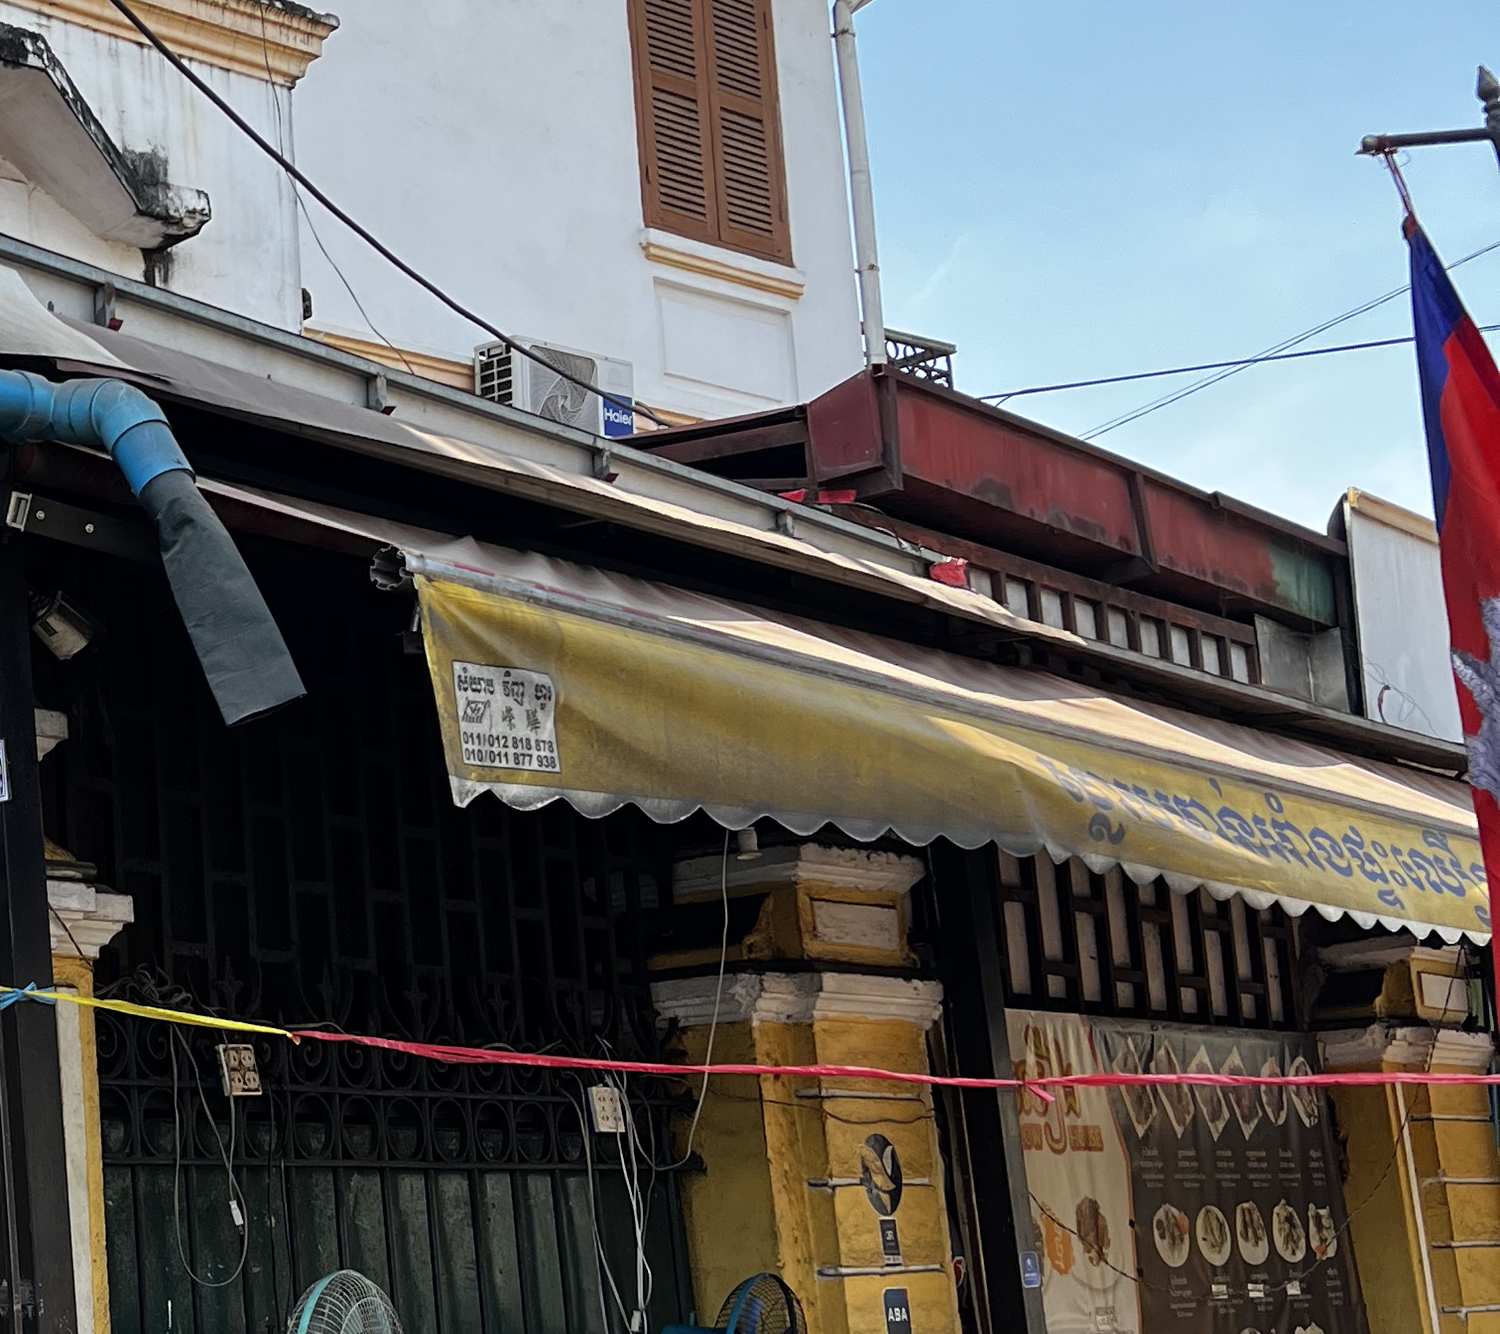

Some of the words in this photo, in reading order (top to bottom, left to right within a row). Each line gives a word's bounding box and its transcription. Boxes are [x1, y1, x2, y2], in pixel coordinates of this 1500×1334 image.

[604, 408, 632, 425] Haier
[462, 731, 509, 749] 011/012
[511, 735, 533, 751] 818
[535, 739, 554, 753] 878
[464, 748, 510, 765] 010/011
[513, 750, 533, 767] 877
[536, 754, 557, 770] 938
[888, 1307, 909, 1323] ABA
